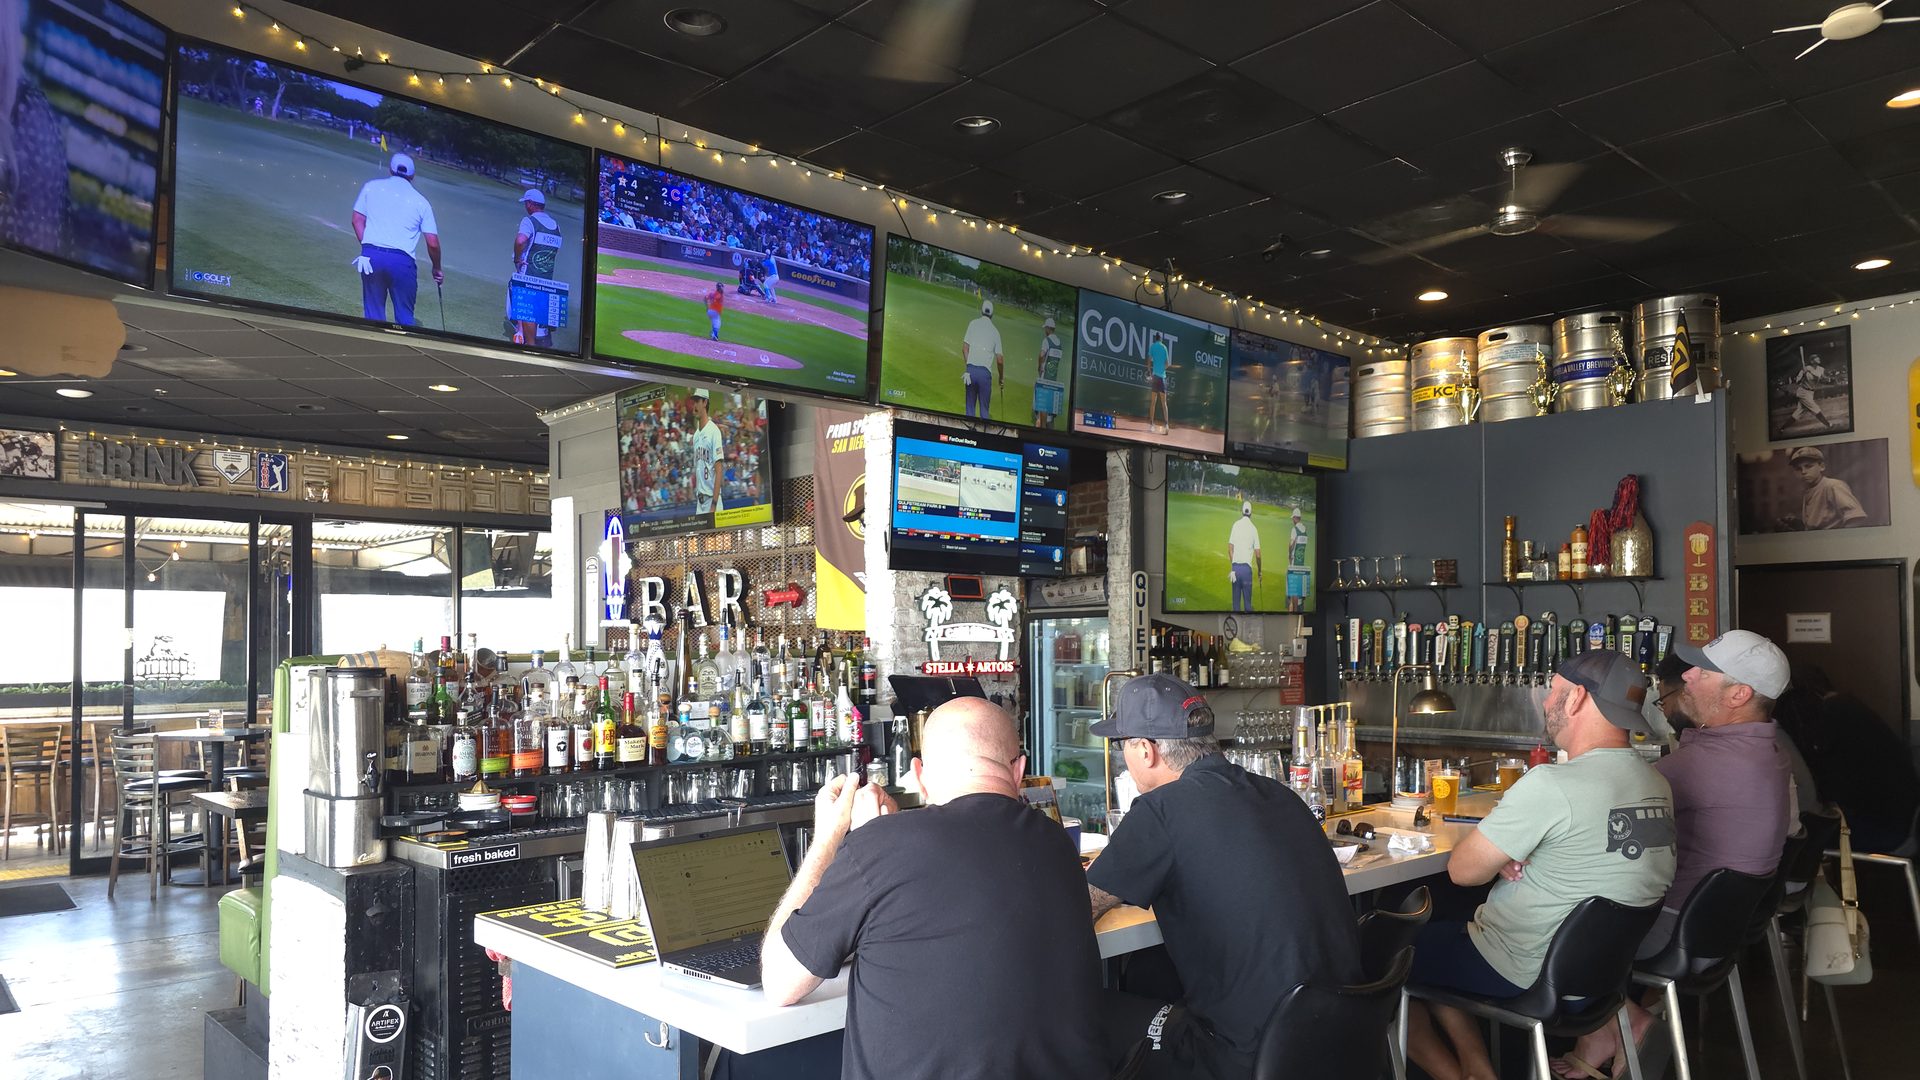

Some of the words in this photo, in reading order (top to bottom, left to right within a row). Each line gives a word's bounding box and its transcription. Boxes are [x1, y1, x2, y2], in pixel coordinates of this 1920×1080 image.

[631, 180, 638, 189] 4
[661, 188, 668, 197] 2
[203, 272, 226, 283] GOLF
[791, 271, 837, 288] GOODYEAR
[1195, 350, 1223, 369] GONET
[1568, 361, 1586, 373] VALLEY
[1586, 360, 1614, 370] BREWING
[1433, 386, 1453, 397] KC
[826, 421, 852, 439] PROUD
[831, 437, 848, 454] SAN
[79, 440, 200, 487] DRINK
[261, 461, 270, 488] TOUR
[898, 500, 926, 508] GULFSTREAM
[639, 568, 746, 630] BAR
[1135, 573, 1147, 662] QUIET
[925, 662, 966, 674] STELLA
[975, 661, 1014, 673] ARTOIS
[602, 729, 615, 746] J&B
[454, 849, 482, 865] fresh
[484, 847, 517, 861] baked
[371, 1018, 399, 1027] ARTIFEX
